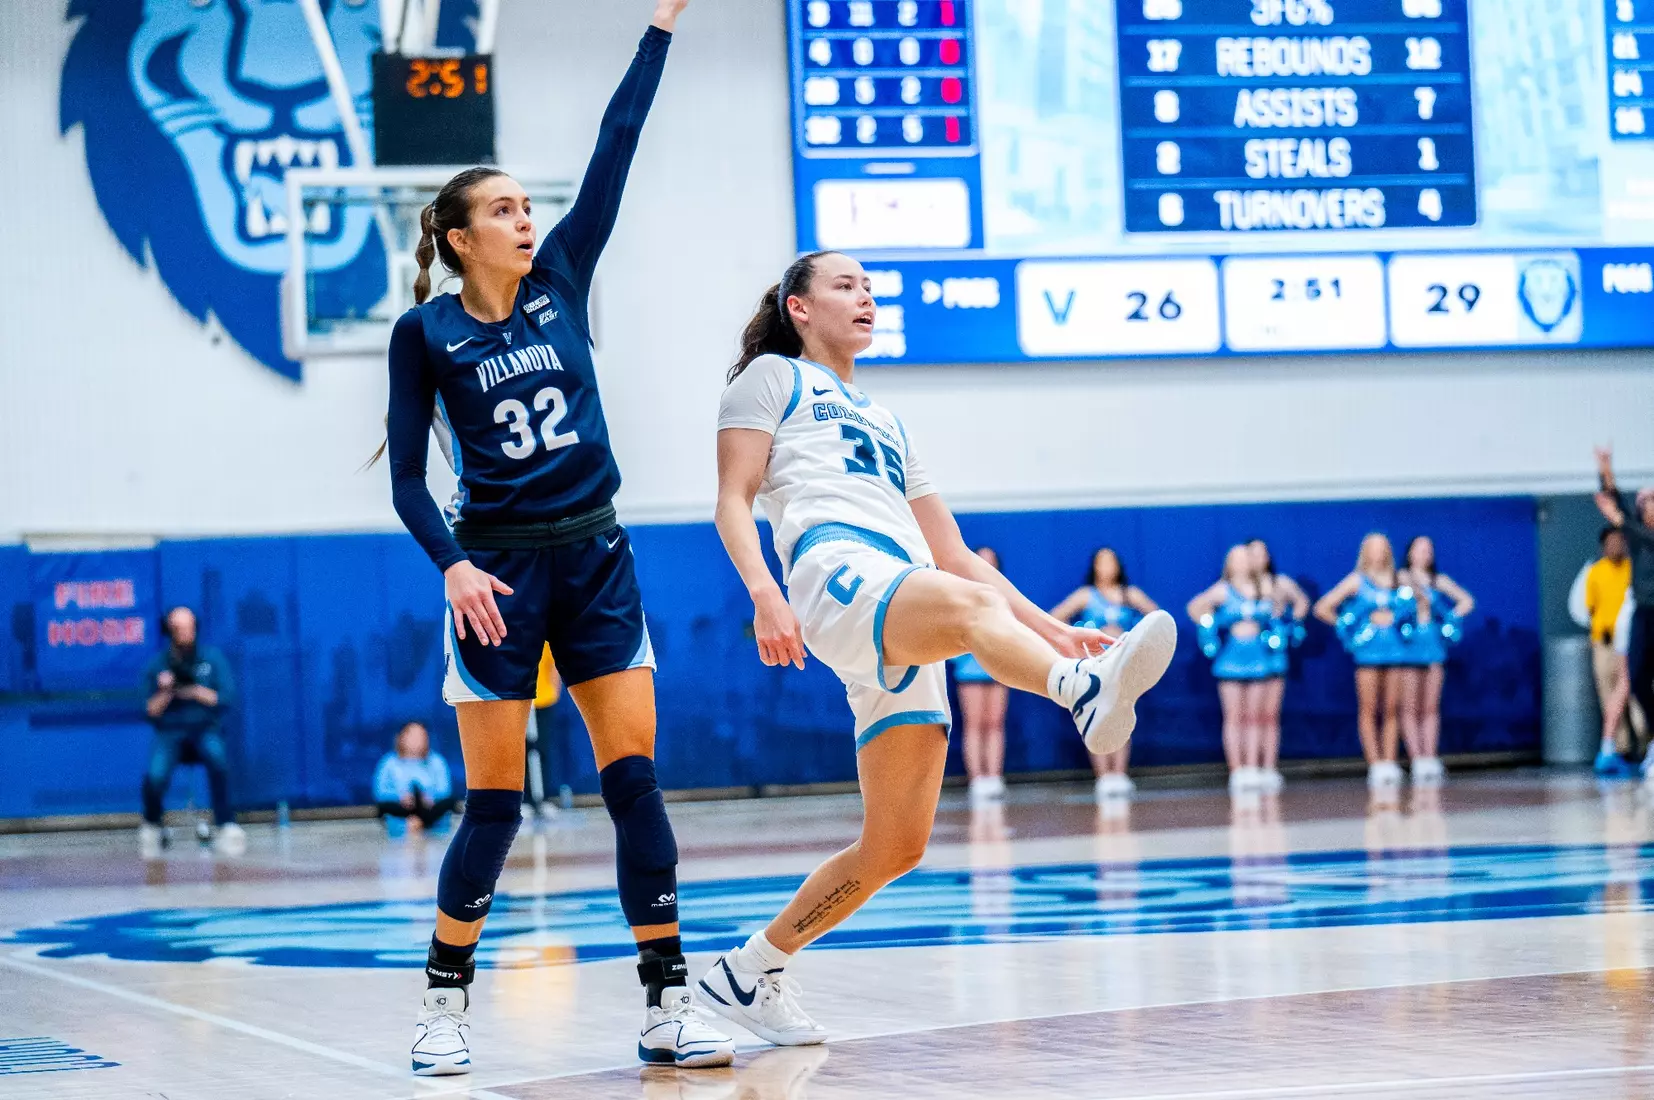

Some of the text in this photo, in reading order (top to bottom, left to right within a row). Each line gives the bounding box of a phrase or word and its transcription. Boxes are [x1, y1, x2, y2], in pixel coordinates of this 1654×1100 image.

[1216, 36, 1372, 77] REBOUNDS
[1234, 87, 1358, 128] ASSISTS
[1414, 87, 1437, 119] 7
[1244, 137, 1352, 178] STEALS
[1418, 137, 1439, 170] 1
[1213, 188, 1386, 230] TURNOVERS
[1125, 289, 1183, 321] 26
[1427, 283, 1482, 313] 29
[476, 344, 565, 393] VILLANOVA
[493, 387, 580, 460] 32
[838, 422, 907, 497] 35
[826, 563, 865, 607] C
